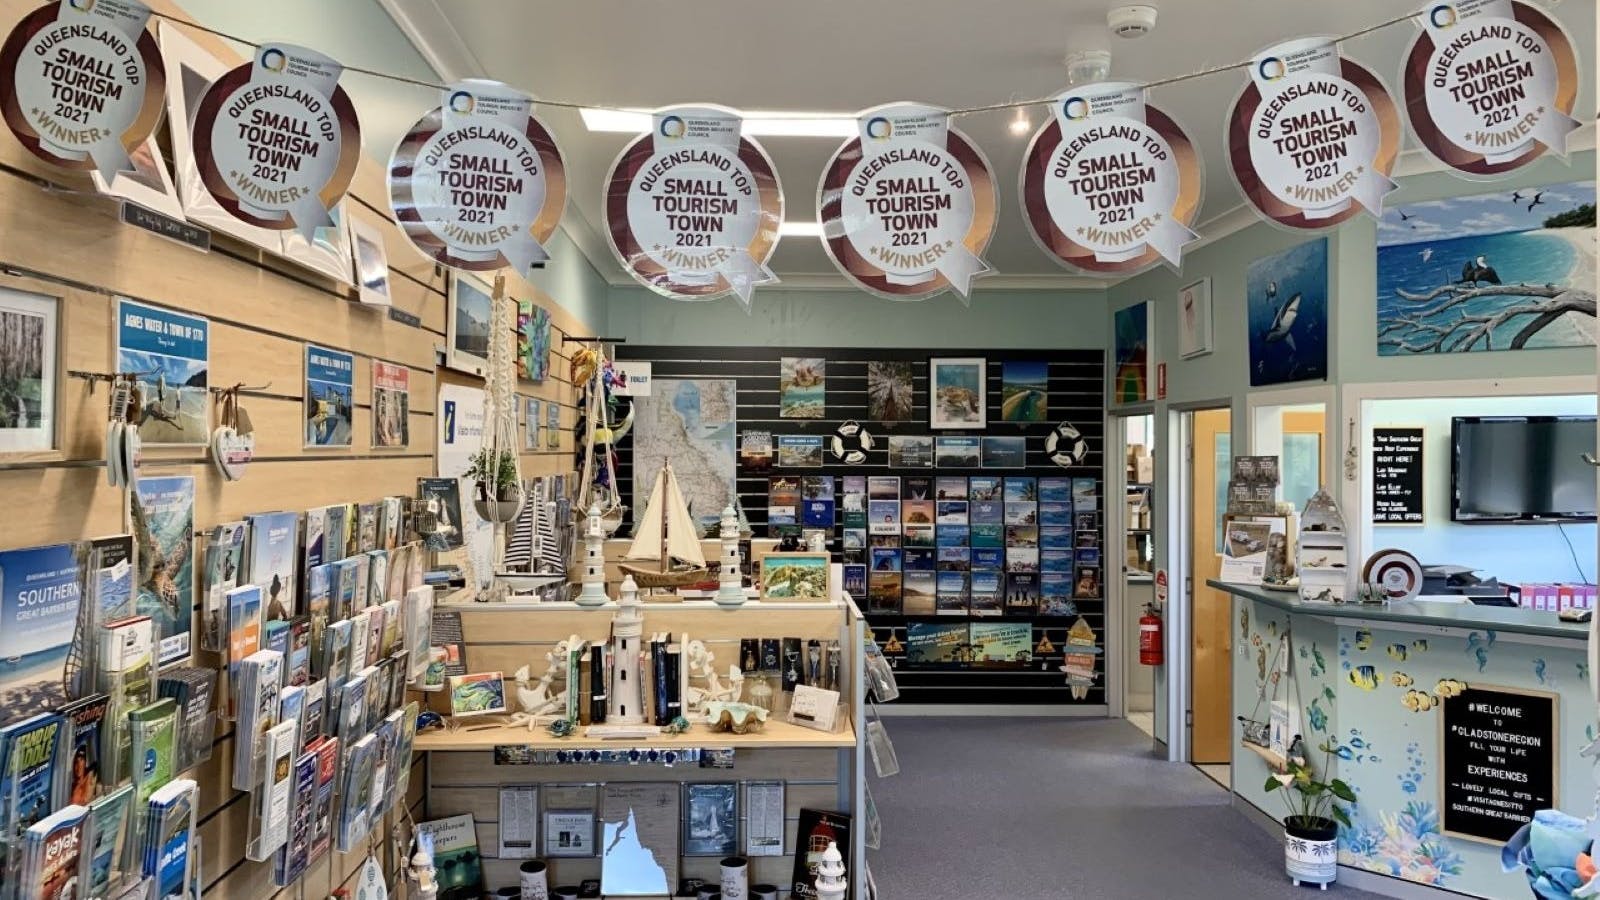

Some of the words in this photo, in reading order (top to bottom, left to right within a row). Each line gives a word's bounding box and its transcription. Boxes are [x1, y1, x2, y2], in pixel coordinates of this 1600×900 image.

[35, 25, 127, 56] QUEENSLAND
[123, 56, 139, 85] TOP
[56, 48, 115, 80] SMALL
[1434, 26, 1511, 87] QUEENSLAND
[1515, 32, 1541, 56] TOP
[1456, 50, 1519, 82] SMALL
[43, 61, 122, 100] TOURISM
[1450, 62, 1533, 102] TOURISM
[51, 83, 105, 113] TOWN
[1258, 82, 1338, 139] QUEENSLAND
[1342, 90, 1365, 114] TOP
[1468, 84, 1525, 115] TOWN
[54, 104, 89, 124] 2021
[229, 85, 321, 118] QUEENSLAND
[317, 112, 334, 141] TOP
[251, 110, 311, 137] SMALL
[1281, 107, 1343, 135] SMALL
[1484, 105, 1519, 127] 2021
[37, 112, 101, 144] WINNER
[238, 123, 319, 157] TOURISM
[1273, 121, 1357, 155] TOURISM
[1475, 111, 1539, 147] WINNER
[248, 144, 301, 171] TOWN
[425, 126, 517, 166] QUEENSLAND
[517, 147, 537, 176] TOP
[1055, 126, 1140, 178] QUEENSLAND
[1142, 136, 1166, 161] TOP
[1291, 141, 1347, 169] TOWN
[253, 164, 286, 184] 2021
[450, 154, 512, 175] SMALL
[640, 150, 730, 192] QUEENSLAND
[731, 168, 751, 196] TOP
[852, 149, 940, 197] QUEENSLAND
[941, 162, 963, 189] TOP
[1078, 152, 1142, 176] SMALL
[1305, 162, 1339, 182] 2021
[236, 174, 300, 204] WINNER
[438, 171, 522, 194] TOURISM
[664, 179, 727, 196] SMALL
[876, 177, 940, 196] SMALL
[1069, 167, 1155, 195] TOURISM
[1294, 171, 1357, 202] WINNER
[450, 190, 507, 210] TOWN
[652, 196, 737, 215] TOURISM
[866, 194, 951, 214] TOURISM
[1086, 188, 1144, 211] TOWN
[459, 209, 494, 224] 2021
[666, 215, 722, 232] TOWN
[881, 213, 937, 231] TOWN
[1099, 207, 1134, 225] 2021
[444, 223, 511, 245] WINNER
[676, 234, 711, 246] 2021
[892, 232, 927, 246] 2021
[1083, 217, 1154, 246] WINNER
[662, 246, 729, 269] WINNER
[878, 243, 946, 269] WINNER
[125, 313, 143, 329] AGNES
[145, 318, 162, 333] WATER
[170, 323, 184, 337] TOWN
[186, 327, 191, 338] OF
[18, 580, 80, 607] SOUTHERN
[1468, 703, 1522, 718] #WELCOME
[1452, 725, 1541, 747] #GLADSTONEREGION
[1470, 741, 1484, 750] FILL
[1490, 745, 1506, 753] YOUR
[1510, 747, 1526, 756] LIFE
[1488, 755, 1505, 764] WITH
[1468, 765, 1528, 783] EXPERIENCES
[1461, 783, 1484, 792] LOVELY
[1489, 787, 1509, 797] LOCAL
[1513, 791, 1532, 801] GIFTS
[1452, 803, 1484, 815] SOUTHERN
[1485, 809, 1503, 818] GREAT
[1504, 812, 1531, 823] BARRIER
